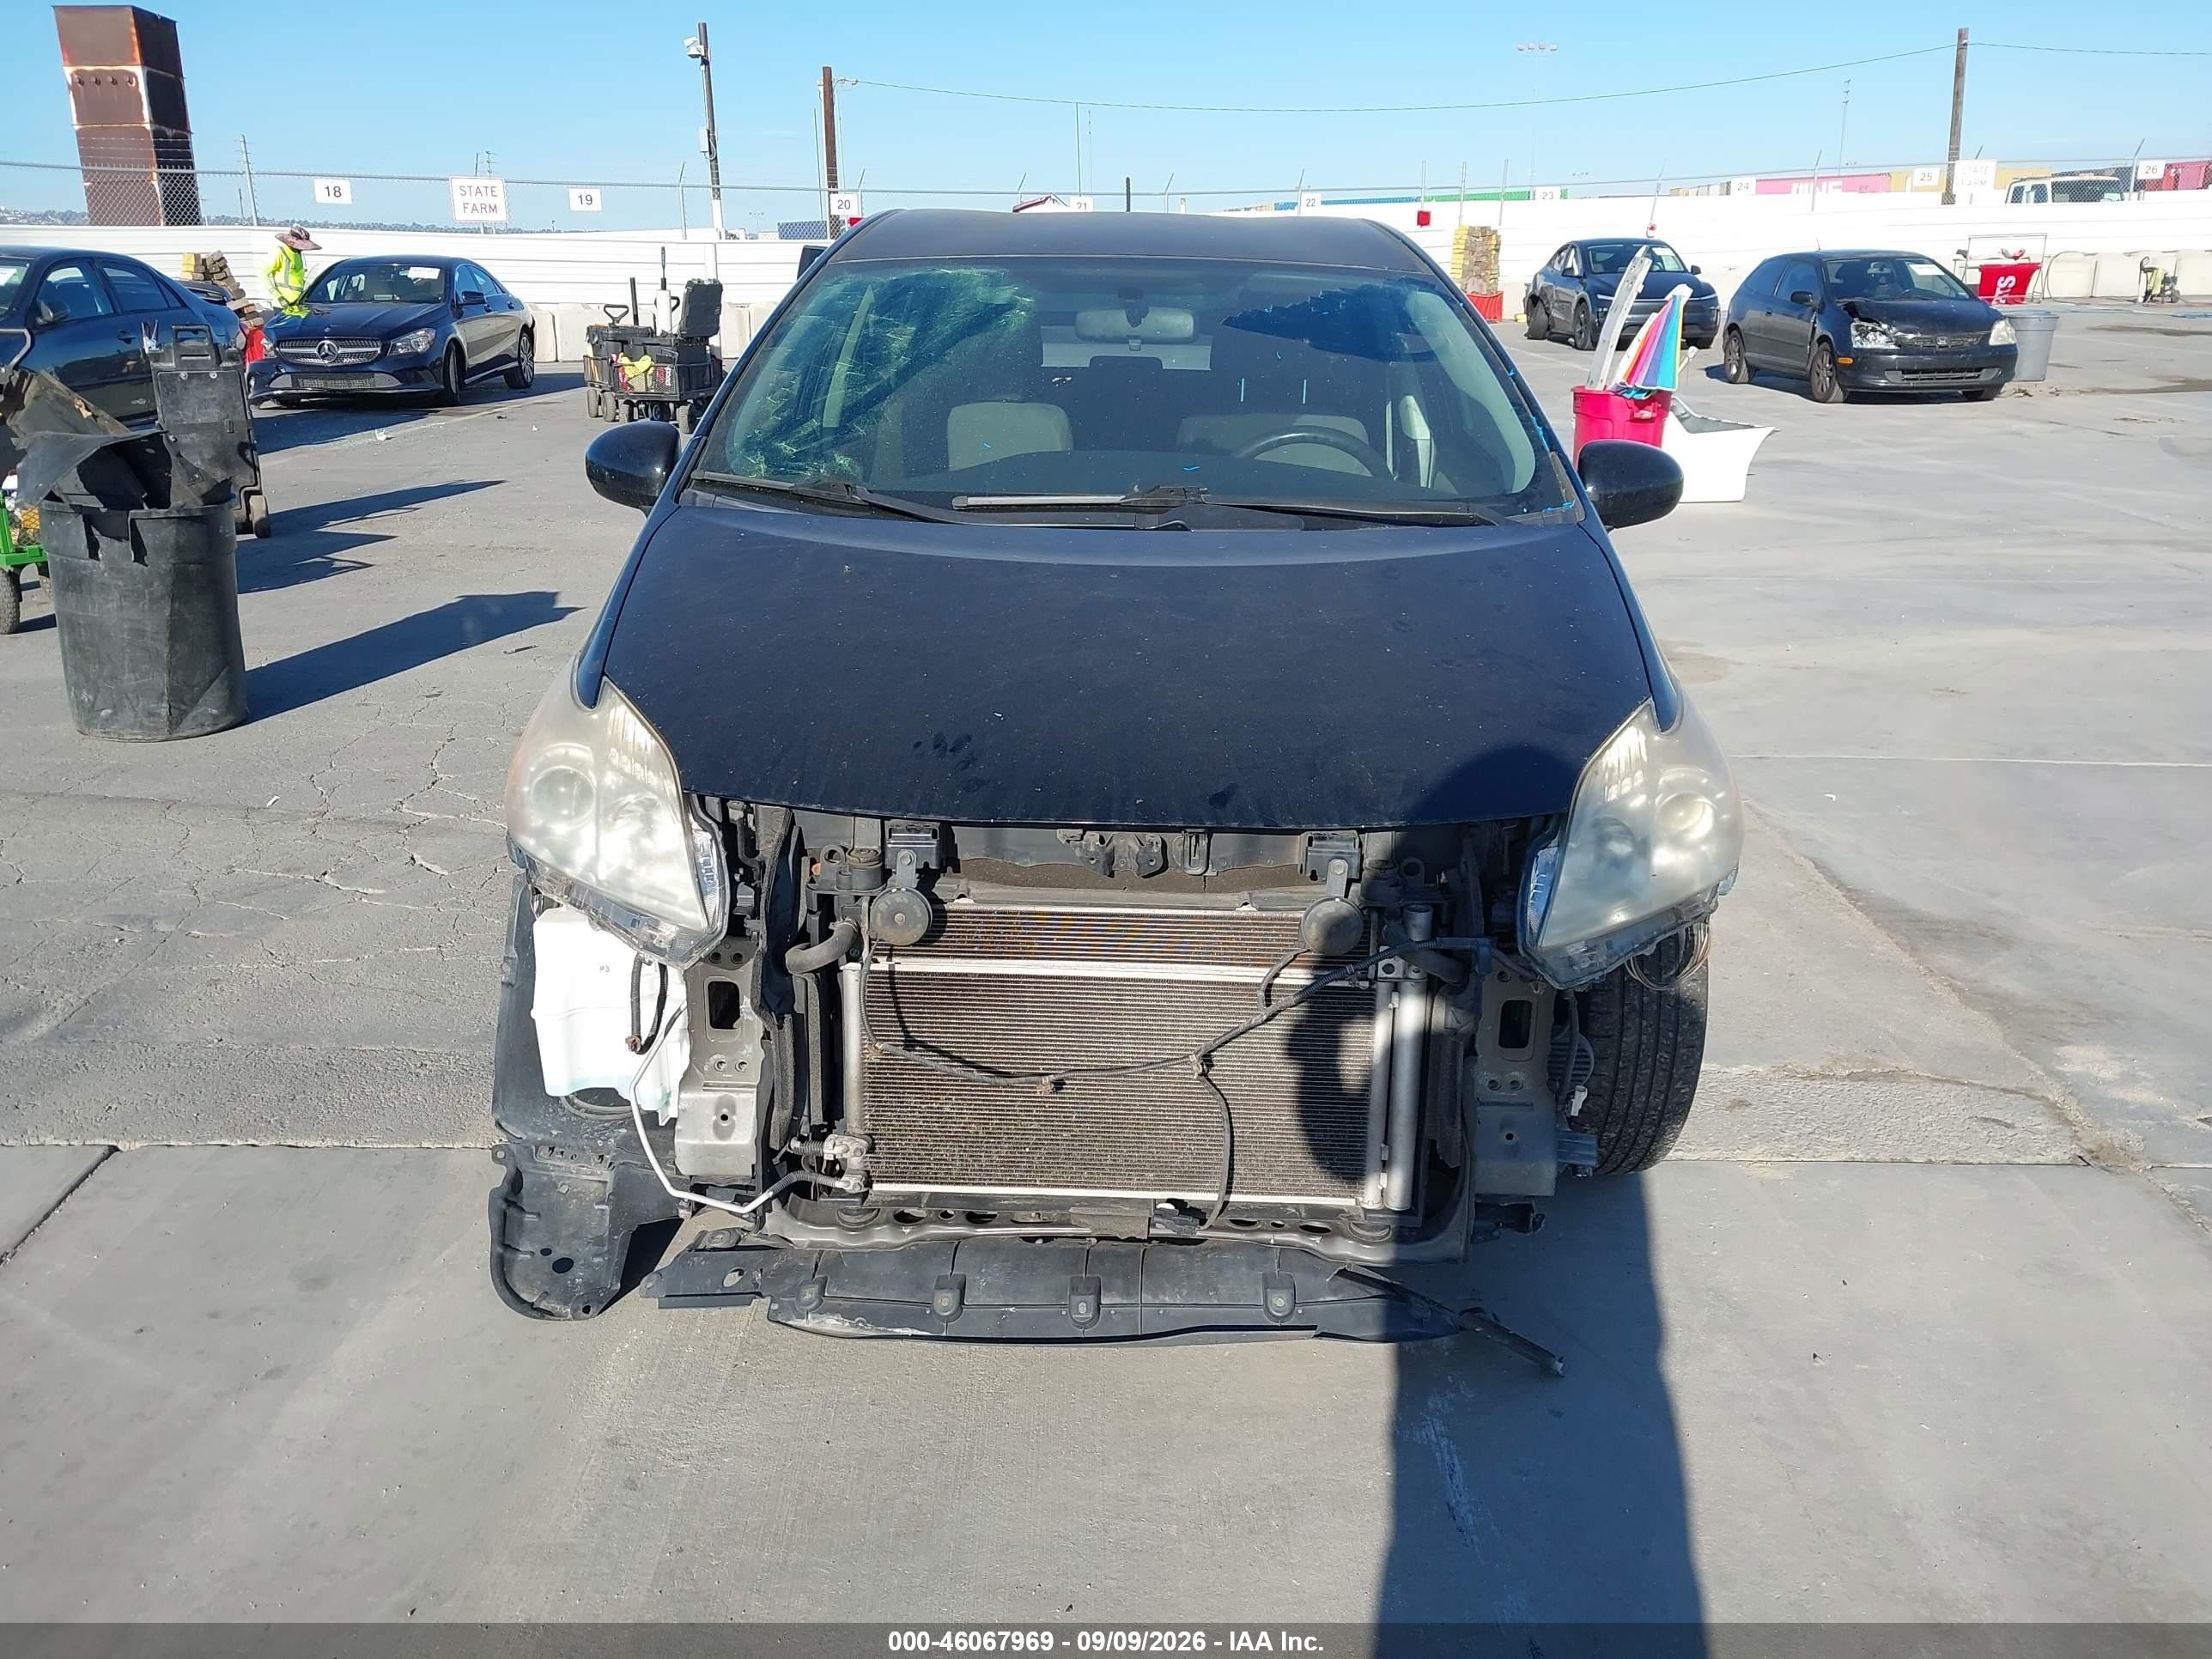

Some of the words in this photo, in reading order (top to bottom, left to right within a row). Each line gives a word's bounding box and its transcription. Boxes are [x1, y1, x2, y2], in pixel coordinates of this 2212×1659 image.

[2145, 165, 2158, 174] 26
[1920, 172, 1932, 181] 25
[324, 185, 342, 198] 18
[459, 185, 498, 198] STATE
[1737, 182, 1749, 191] 24
[577, 194, 593, 206] 19
[1542, 191, 1554, 200] 23
[837, 199, 851, 210] 20
[1305, 198, 1316, 207] 22
[462, 202, 498, 215] FARM
